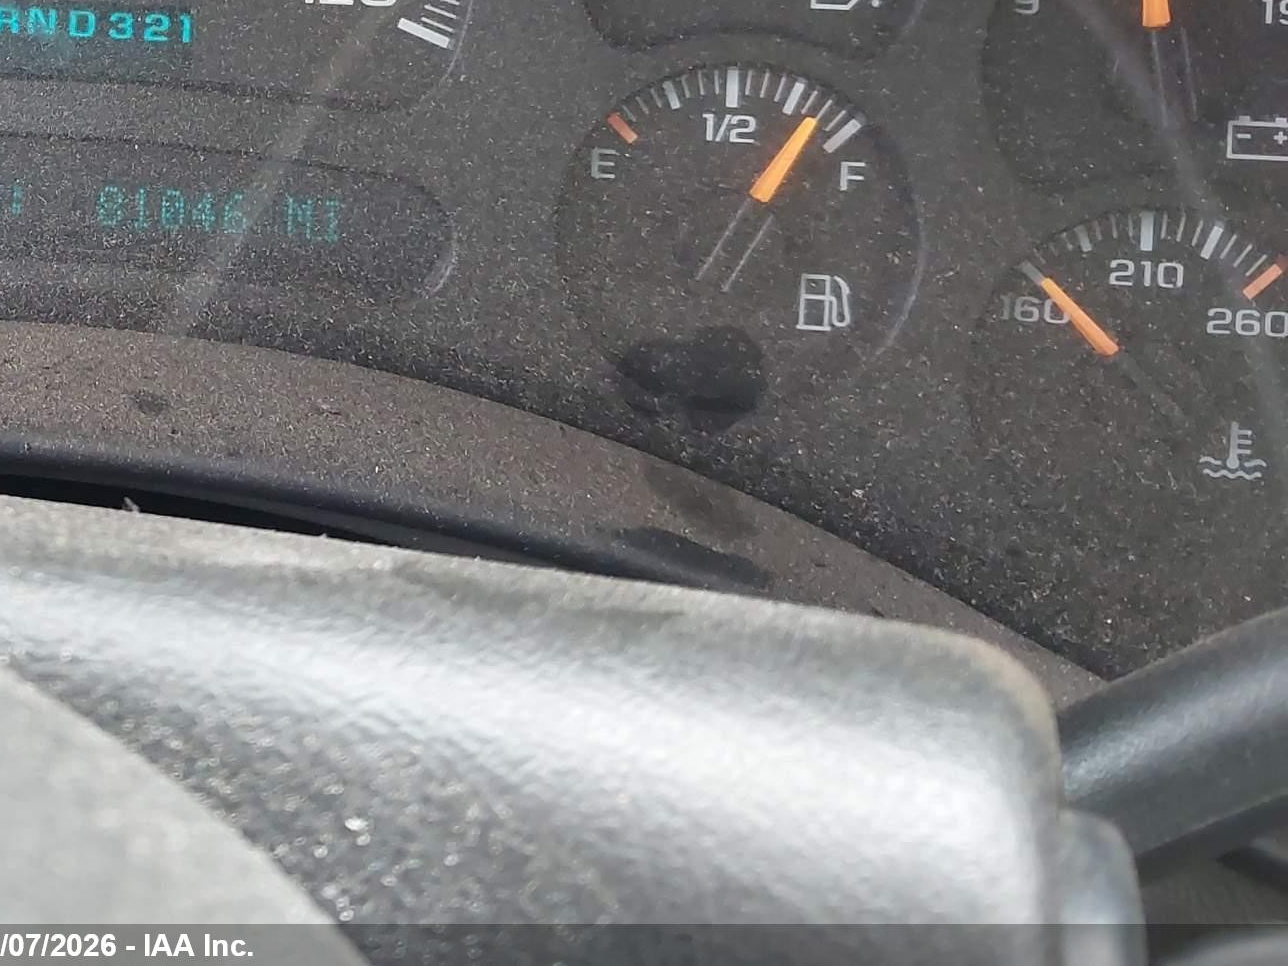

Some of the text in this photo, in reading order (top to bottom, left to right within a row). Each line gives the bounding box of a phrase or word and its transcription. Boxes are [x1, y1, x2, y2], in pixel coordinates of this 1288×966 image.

[702, 113, 757, 144] 1/2
[591, 147, 618, 180] E
[840, 161, 866, 191] F
[286, 195, 340, 242] MI
[1109, 259, 1184, 289] 210
[1207, 307, 1288, 337] 260
